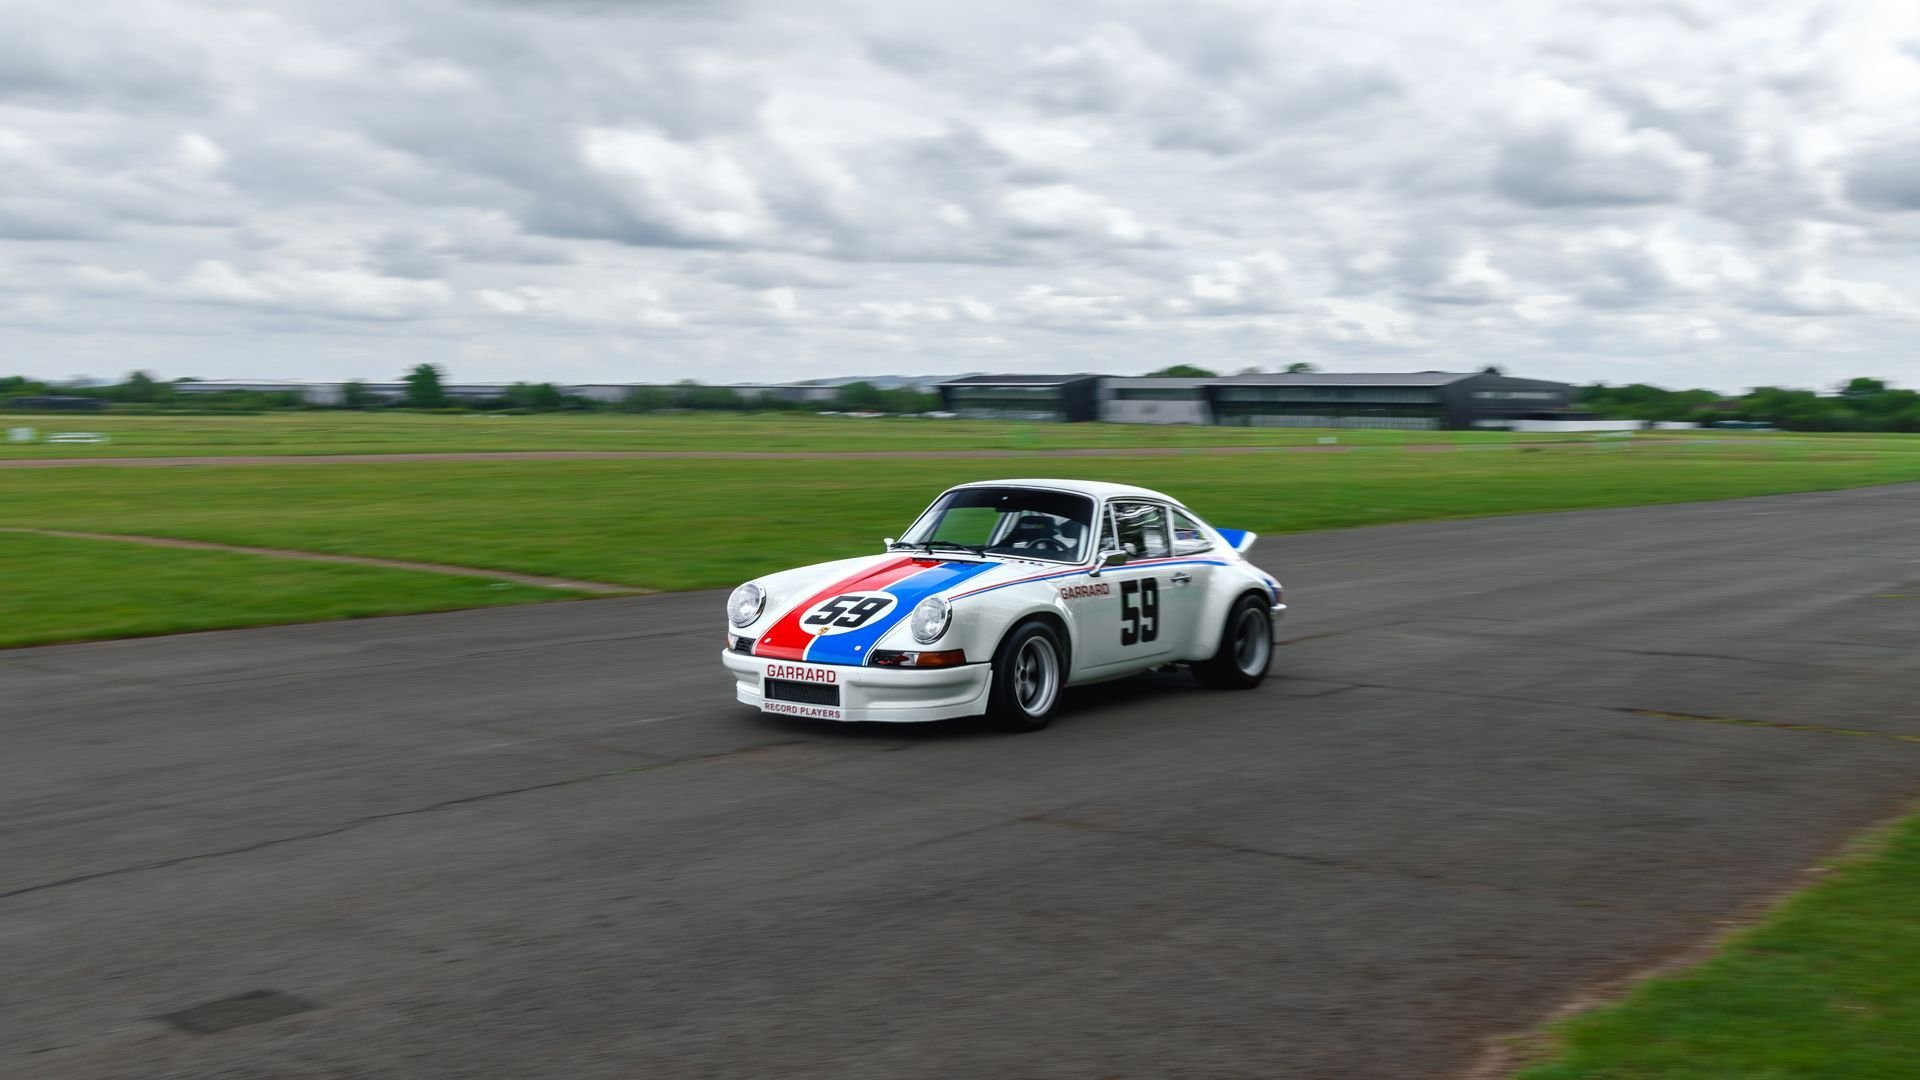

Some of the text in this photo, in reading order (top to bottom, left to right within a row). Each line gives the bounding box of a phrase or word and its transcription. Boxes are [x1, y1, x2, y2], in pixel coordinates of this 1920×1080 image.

[1060, 583, 1109, 599] GARRARD
[804, 596, 893, 628] 59
[1120, 578, 1158, 646] 59
[767, 664, 836, 683] GARRARD
[764, 702, 841, 719] RECORD PLAYERS
